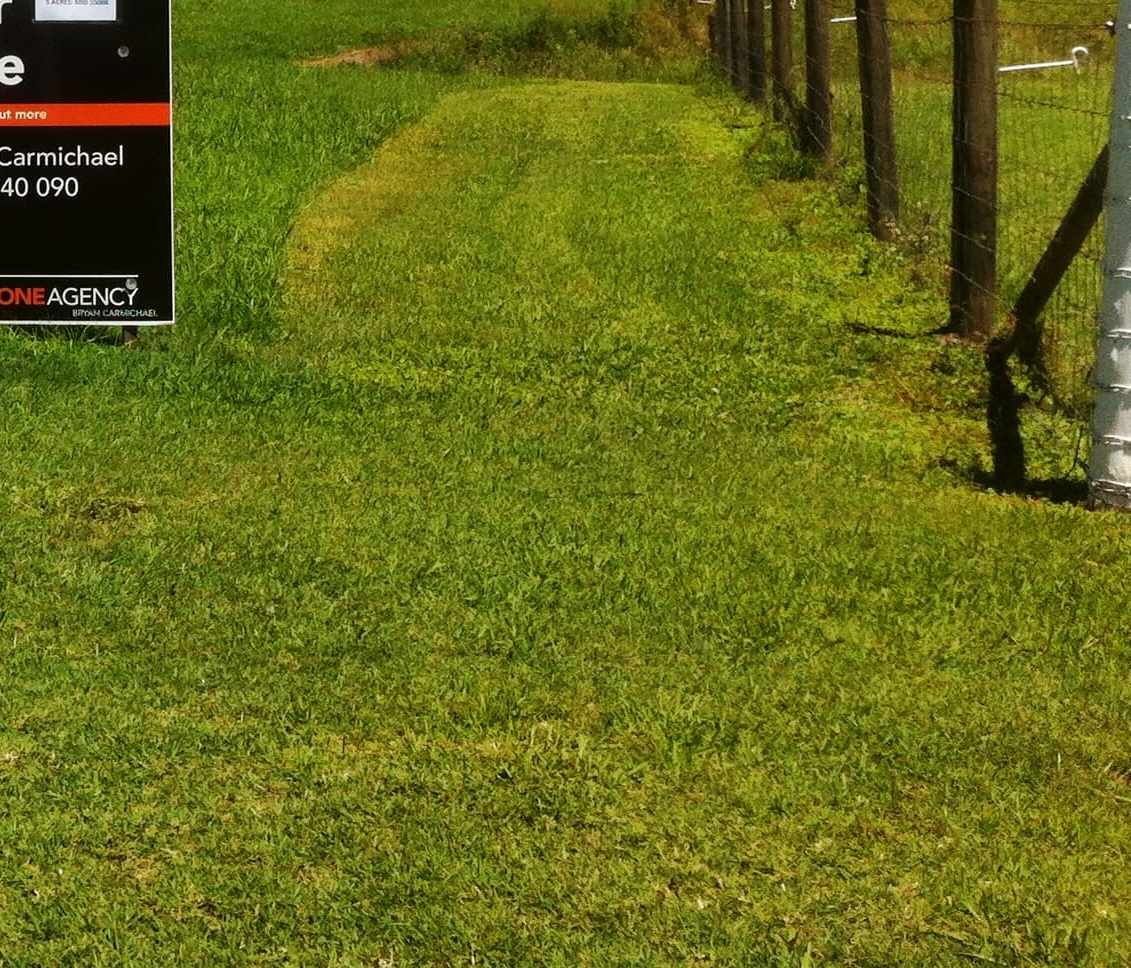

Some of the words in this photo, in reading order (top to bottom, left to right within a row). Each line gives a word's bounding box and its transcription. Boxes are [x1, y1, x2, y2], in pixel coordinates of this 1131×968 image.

[14, 110, 47, 120] more
[36, 177, 79, 197] 090
[72, 309, 101, 318] BRYAN
[102, 309, 158, 318] CARMICHAEL
